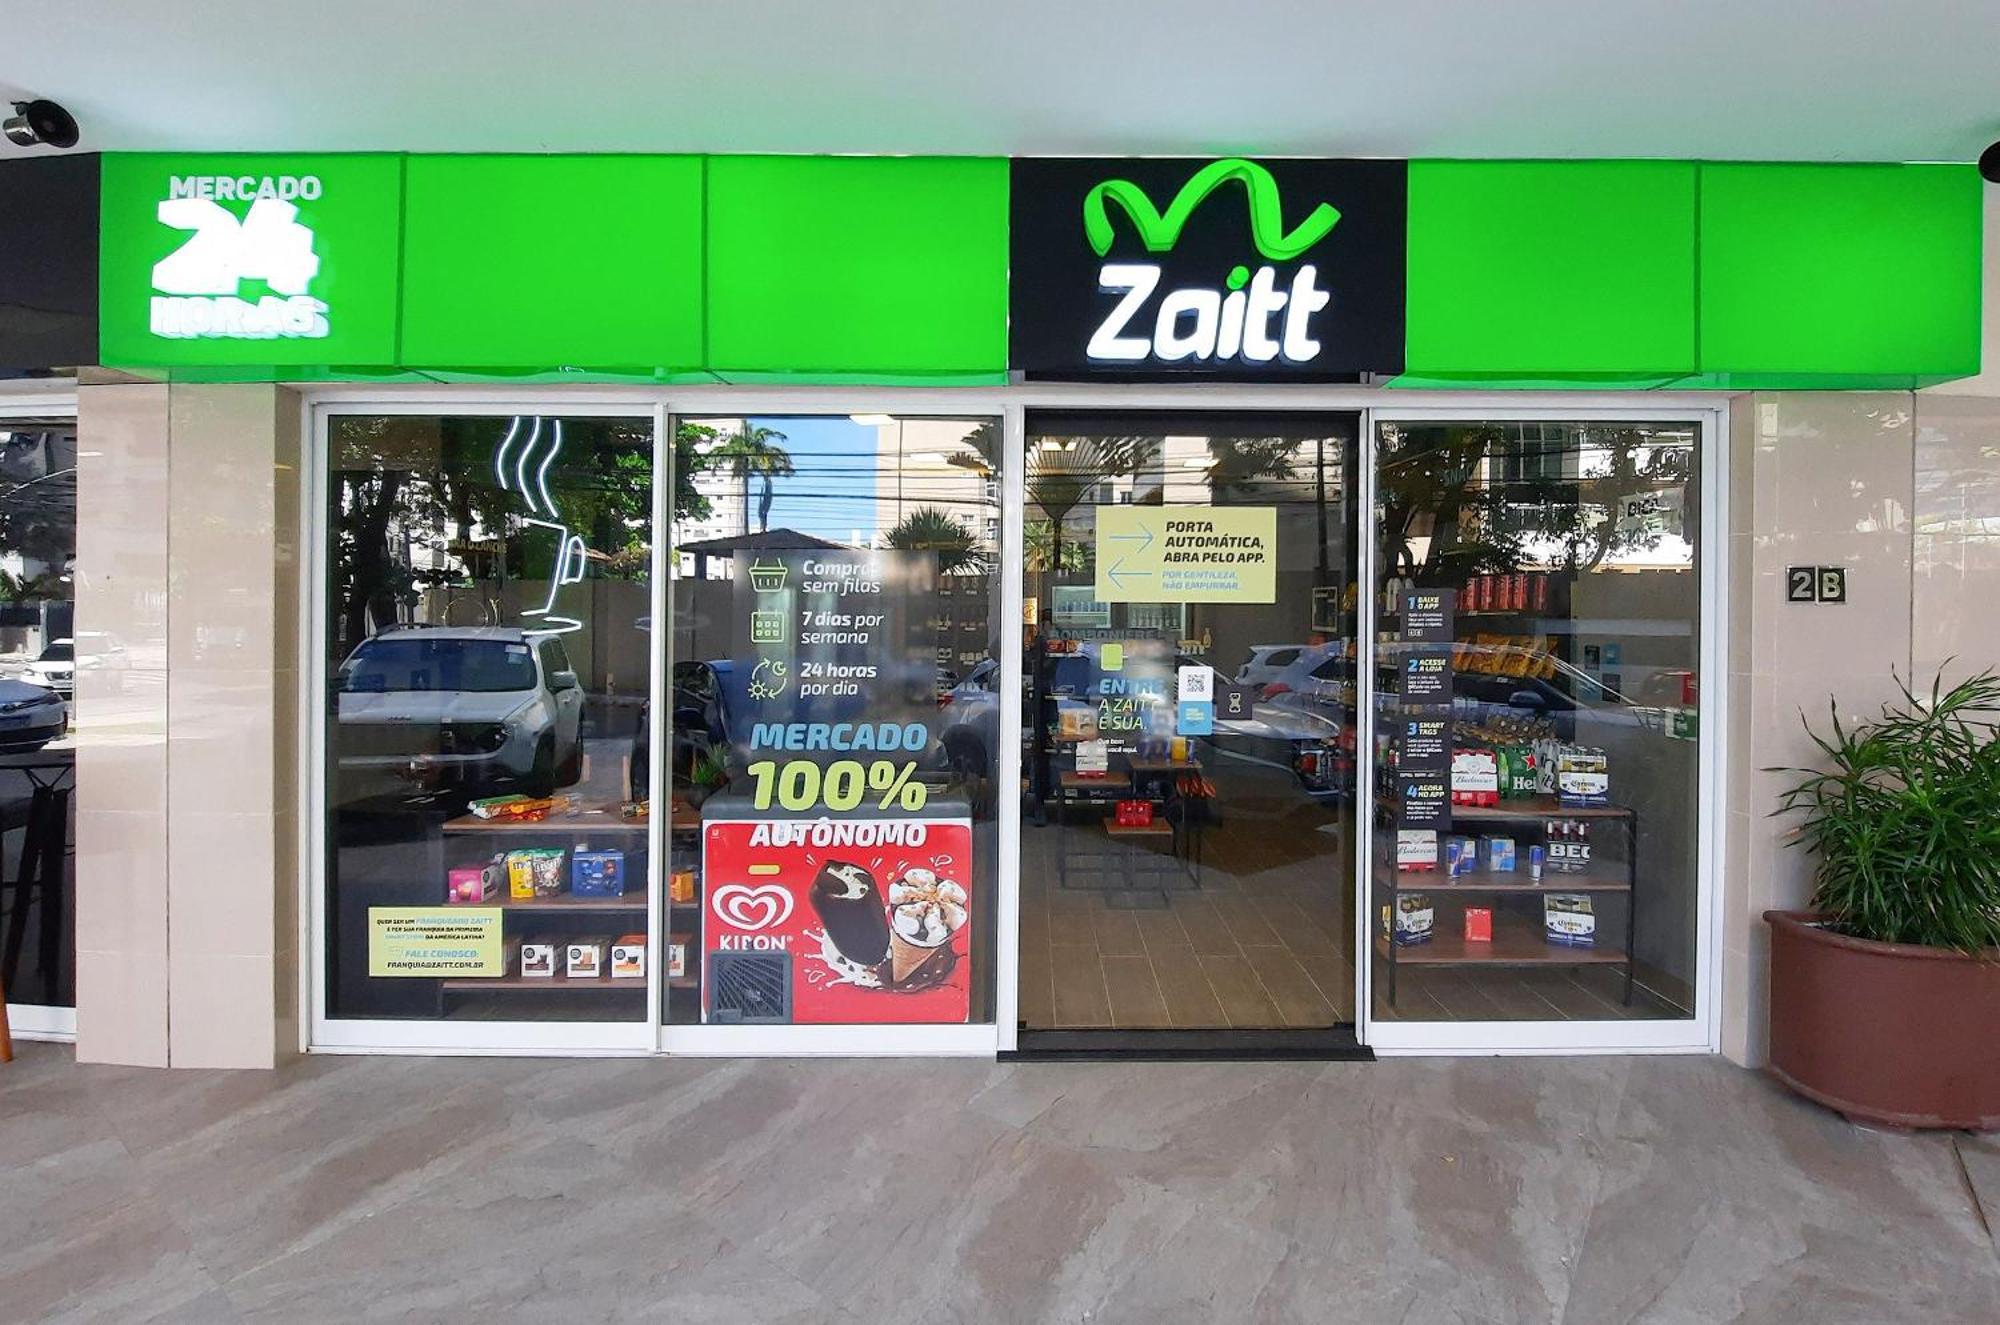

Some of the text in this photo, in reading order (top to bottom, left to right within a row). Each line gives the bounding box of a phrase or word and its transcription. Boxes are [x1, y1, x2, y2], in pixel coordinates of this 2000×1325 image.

[169, 175, 322, 200] MERCADO
[152, 198, 320, 296] 24
[150, 295, 330, 339] HORAS
[1086, 264, 1330, 363] Zaitt
[1166, 521, 1213, 533] PORTA
[1165, 533, 1264, 549] AUTOMÁTICA,
[1164, 552, 1265, 563] ABRA PELO APP.
[1162, 571, 1181, 579] POR
[802, 578, 881, 596] sem filas
[1162, 580, 1182, 590] NÃO
[1408, 597, 1415, 609] 1
[802, 611, 884, 629] 7 dias por
[801, 632, 868, 644] semana
[800, 662, 877, 678] 24 horas
[1408, 659, 1418, 672] 2
[800, 680, 858, 699] por dia
[1099, 698, 1109, 712] A
[1099, 713, 1147, 730] É SUA.
[1407, 722, 1417, 736] 3
[750, 723, 928, 751] MERCADO
[747, 760, 928, 811] 100%
[1407, 784, 1417, 798] 4
[749, 817, 927, 848] AUTÔNOMO
